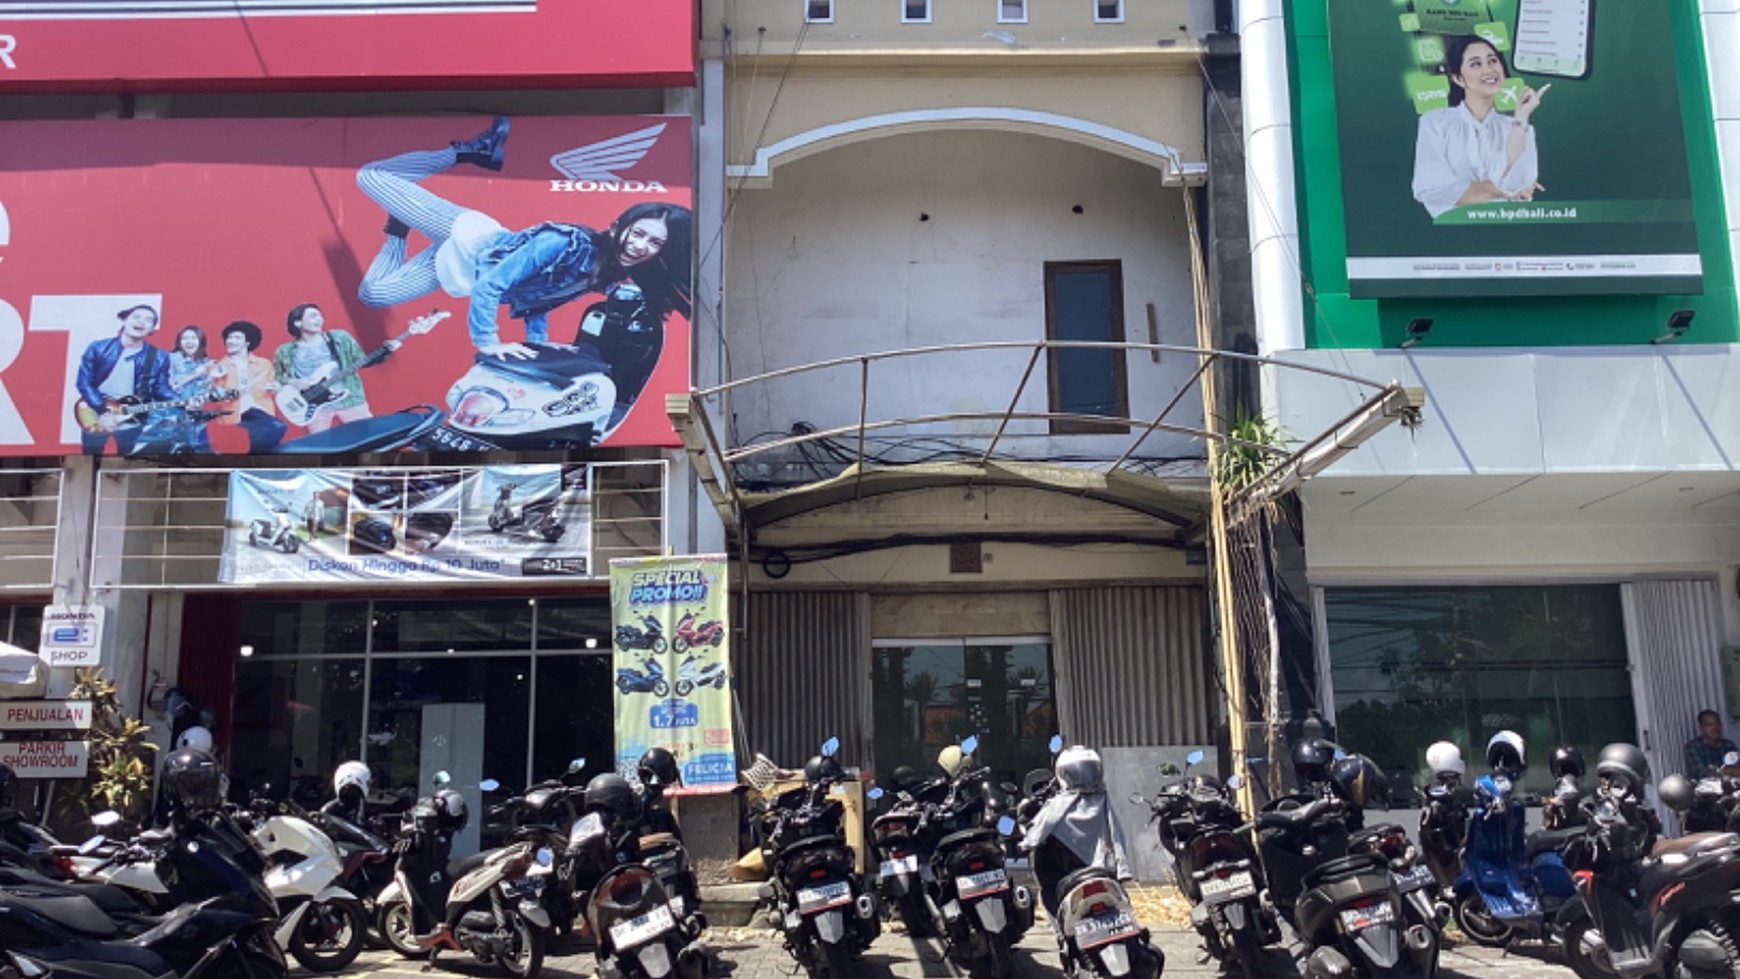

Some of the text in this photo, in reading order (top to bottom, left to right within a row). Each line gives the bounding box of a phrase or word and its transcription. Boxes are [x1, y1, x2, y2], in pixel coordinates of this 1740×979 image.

[549, 179, 668, 193] HONDA
[1467, 207, 1577, 220] www.bpdbali.co.id
[308, 559, 358, 571] Diskon
[362, 560, 417, 573] Hingga
[632, 571, 702, 585] SPECIAL
[630, 585, 705, 603] PROMO!!
[50, 611, 96, 620] HONDA
[51, 650, 88, 661] SHOP
[7, 708, 84, 722] PENJUALAN
[18, 741, 65, 755] PARKIR
[3, 755, 79, 768] SHOWROOM
[688, 762, 734, 775] FELICIA
